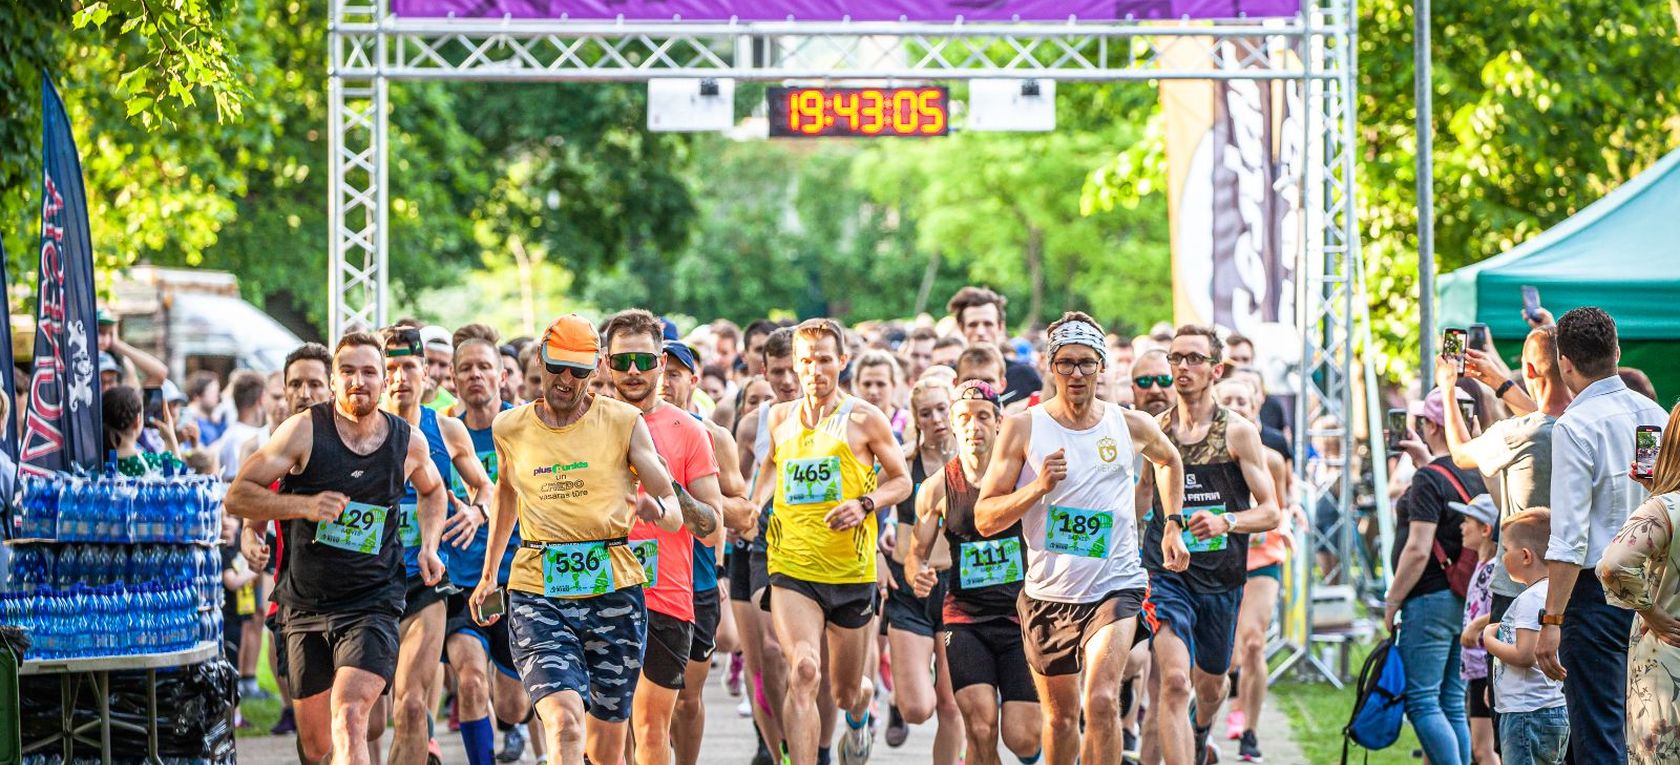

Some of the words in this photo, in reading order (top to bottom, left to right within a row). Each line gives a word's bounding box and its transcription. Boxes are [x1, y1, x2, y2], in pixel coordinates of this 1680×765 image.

[788, 89, 945, 133] 19:43:05
[793, 463, 831, 482] 465
[333, 509, 374, 530] 129
[1059, 513, 1100, 536] 189
[555, 551, 600, 574] 536
[972, 545, 1009, 567] 111
